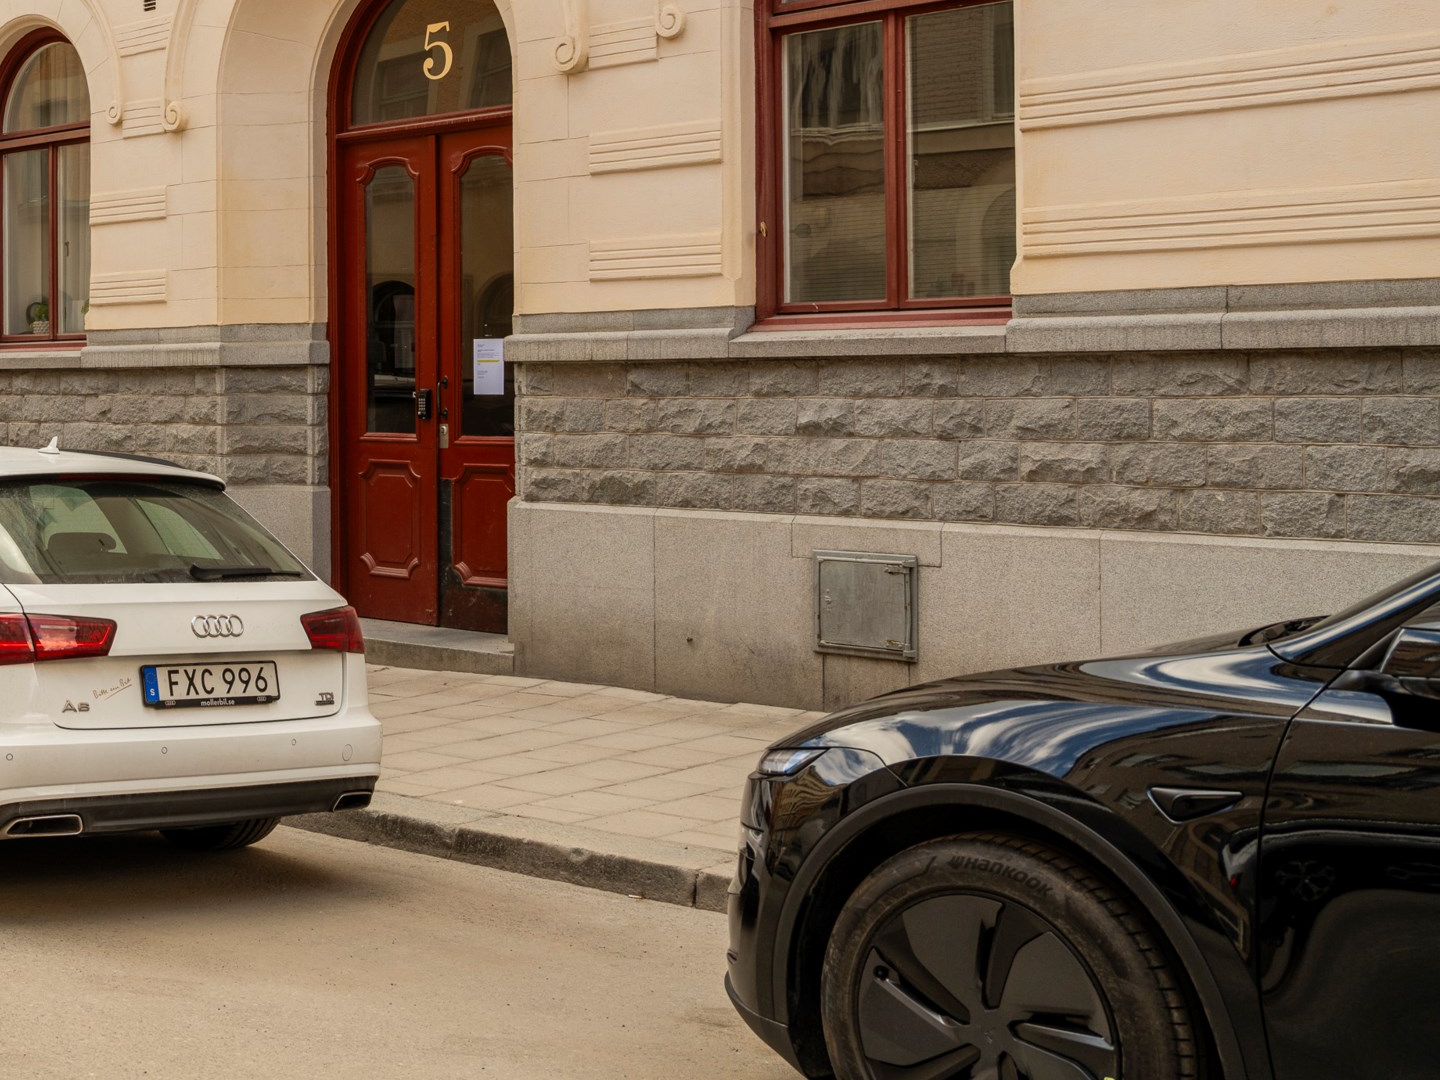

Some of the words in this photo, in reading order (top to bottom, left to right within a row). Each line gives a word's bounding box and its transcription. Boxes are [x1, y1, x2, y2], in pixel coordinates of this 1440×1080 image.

[422, 21, 454, 80] 5
[167, 668, 215, 697] FXC
[221, 666, 269, 695] 996
[150, 688, 156, 696] S
[61, 699, 91, 714] A6
[200, 698, 236, 707] mollerbil.se
